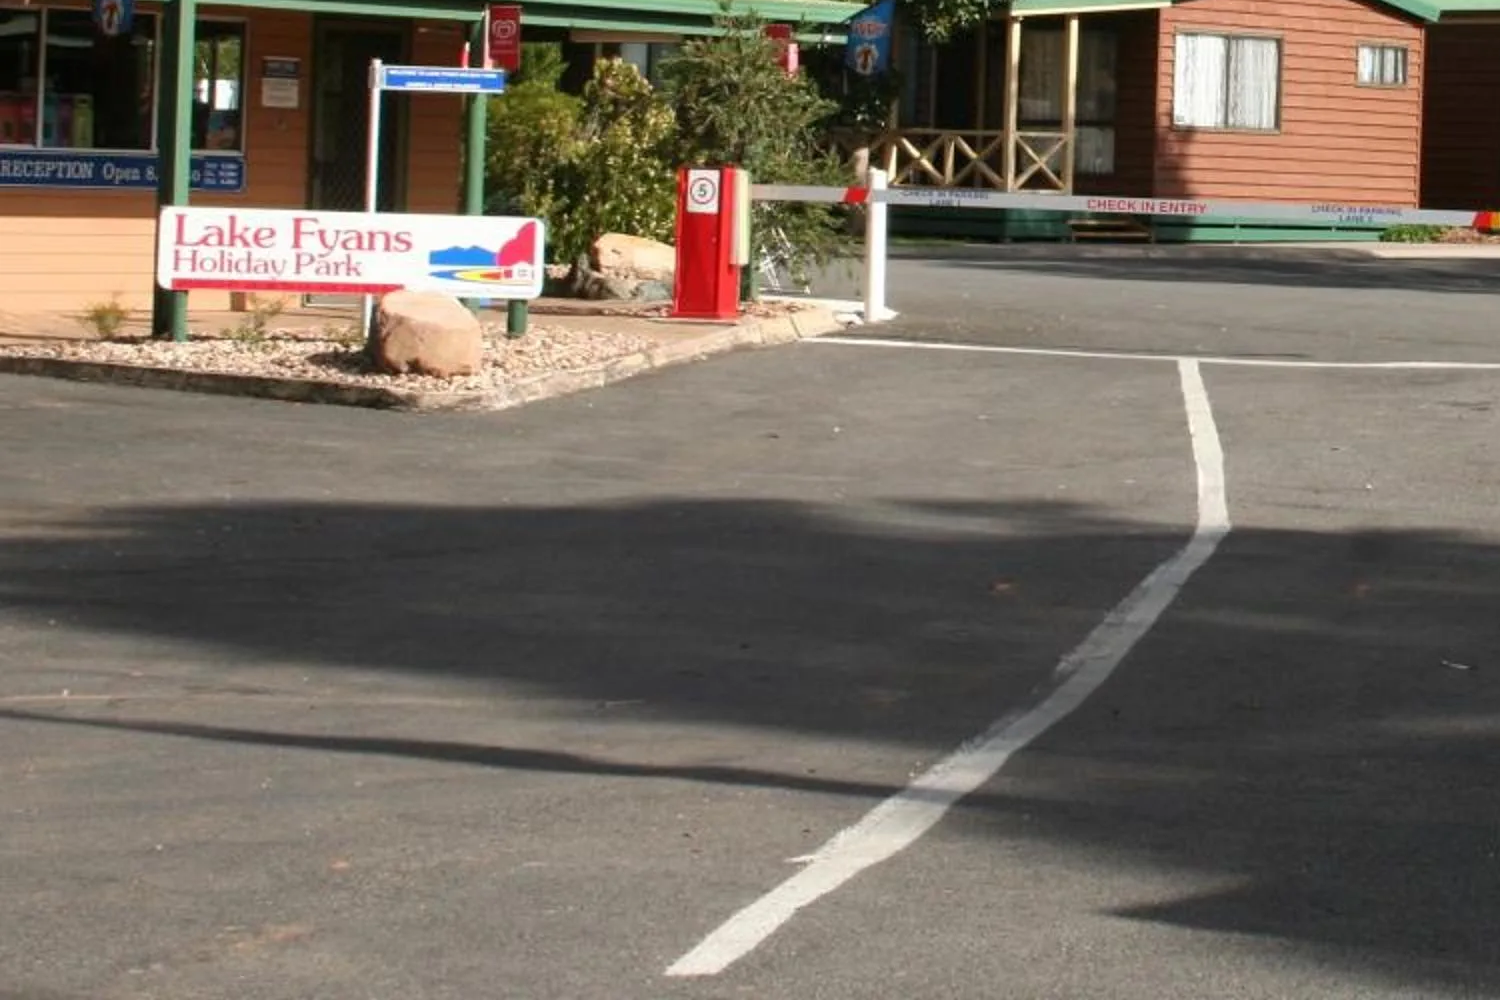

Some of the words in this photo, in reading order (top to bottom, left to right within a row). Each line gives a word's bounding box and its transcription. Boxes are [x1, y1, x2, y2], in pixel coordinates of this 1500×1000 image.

[0, 159, 94, 180] RECEPTION
[103, 162, 141, 184] Open
[697, 183, 707, 197] 5
[1087, 199, 1137, 211] CHECK
[1141, 200, 1155, 212] IN
[1159, 201, 1208, 214] ENTRY
[174, 213, 277, 249] Lake
[292, 217, 413, 257] Fyans
[172, 249, 288, 280] Holiday
[294, 252, 363, 277] Park
